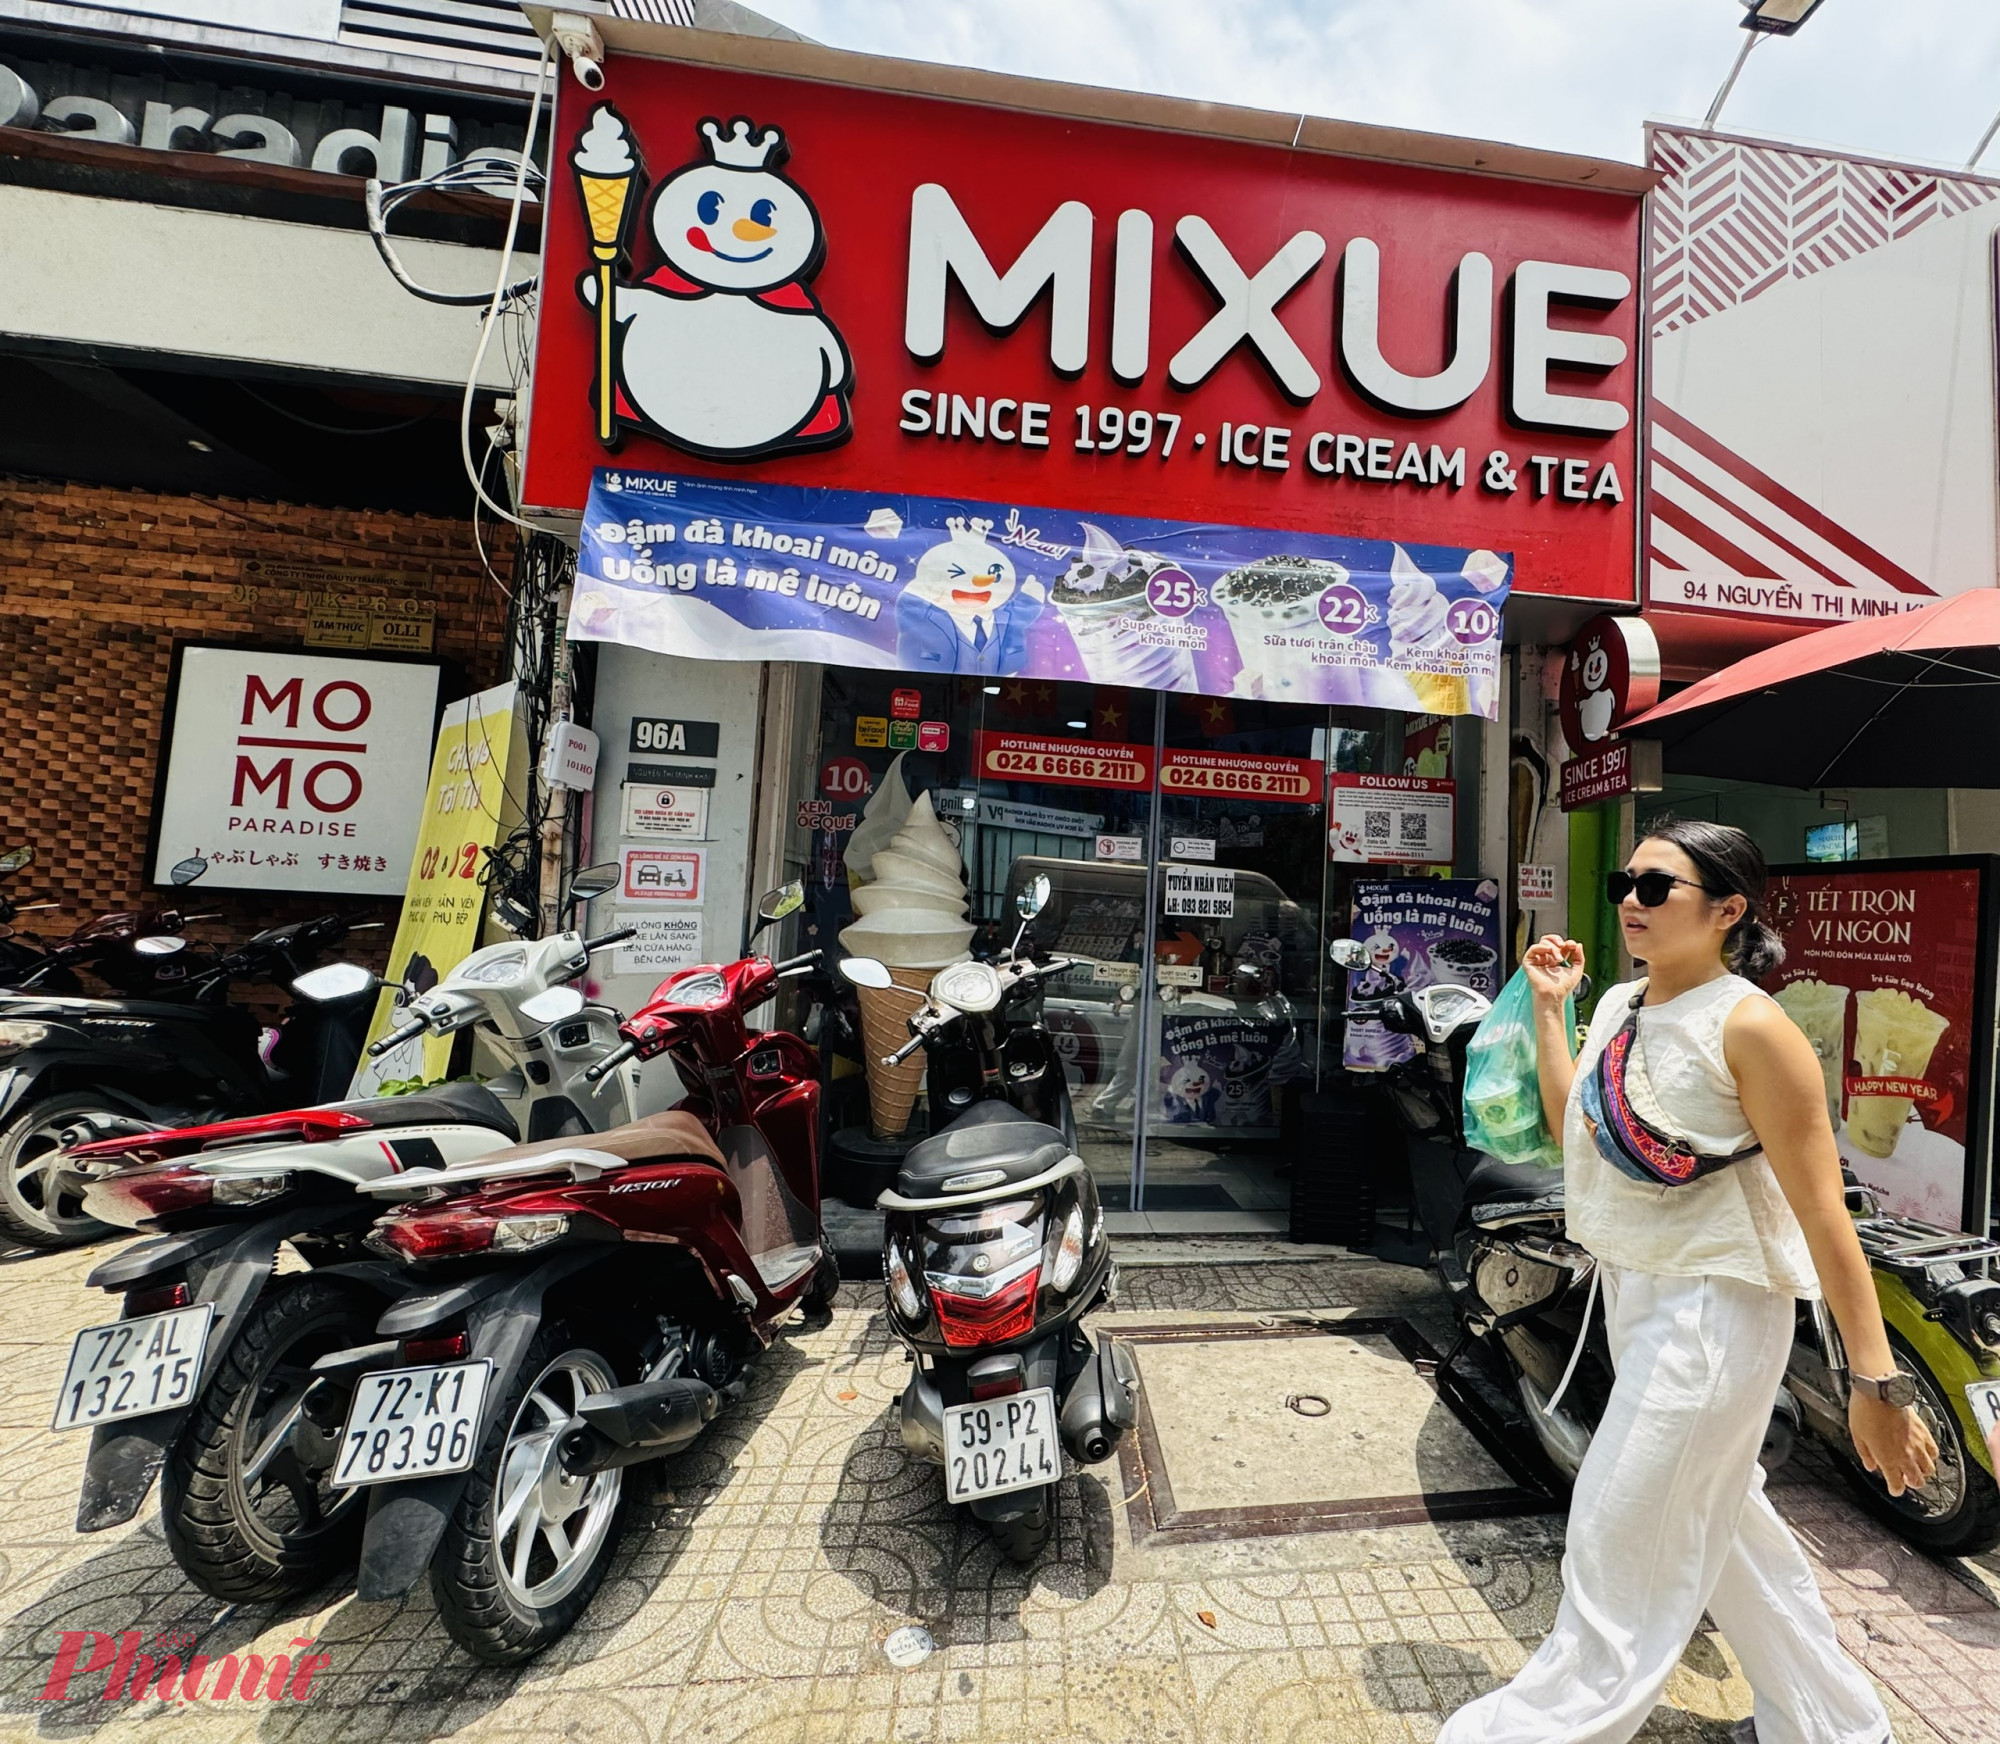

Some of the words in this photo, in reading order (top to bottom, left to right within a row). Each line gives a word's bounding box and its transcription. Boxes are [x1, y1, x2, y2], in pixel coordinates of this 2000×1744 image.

[905, 183, 1632, 432] MIXUE
[900, 388, 1051, 447] SINCE
[1075, 403, 1182, 458] 1997
[1220, 422, 1292, 470] ICE
[1310, 431, 1466, 487] CREAM
[1486, 451, 1518, 491] &
[1532, 455, 1624, 503] TEA
[625, 476, 677, 494] MIXUE
[596, 519, 676, 550] Đậm
[683, 519, 725, 545] đà
[732, 523, 825, 560] khoai
[828, 545, 898, 583] môn
[602, 549, 697, 591] Uống
[705, 558, 738, 587] là
[745, 567, 800, 597] mê
[805, 574, 882, 621] luôn
[1683, 580, 1709, 602] 94
[1718, 582, 1802, 611] NGUYỄN
[1811, 593, 1844, 618] THỊ
[1851, 597, 1898, 617] MINH
[313, 619, 335, 631] TÂM
[337, 618, 365, 633] THỨC
[382, 623, 422, 638] OLLI
[1122, 618, 1159, 633] Super
[1161, 622, 1207, 637] sundae
[1140, 635, 1176, 647] khoai
[1178, 637, 1207, 650] môn
[1263, 634, 1287, 648] Sữa
[1290, 637, 1315, 649] tươi
[1318, 638, 1345, 651] trân
[1347, 639, 1377, 654] châu
[1311, 651, 1347, 666] khoai
[1349, 654, 1377, 668] môn
[1406, 647, 1435, 660] Kem
[1437, 648, 1470, 662] khoai
[1386, 660, 1412, 672] Kem
[1415, 661, 1449, 674] khoai
[1451, 661, 1479, 676] môn
[240, 674, 372, 732] MO
[567, 739, 588, 752] P001
[636, 721, 687, 751] 96A
[1000, 739, 1047, 751] HOTLINE
[1048, 741, 1096, 756] NHƯỢNG
[1097, 744, 1134, 759] QUYỀN
[996, 752, 1038, 772] 024
[1042, 757, 1095, 777] 6666
[1099, 761, 1136, 781] 2111
[1173, 754, 1215, 766] HOTLINE
[1217, 757, 1263, 771] NHƯỢNG
[1264, 759, 1299, 773] QUYỀN
[1564, 757, 1599, 787] SINCE
[1601, 746, 1628, 776] 1997
[230, 755, 363, 813] MO
[1169, 768, 1208, 787] 024
[1212, 771, 1263, 790] 6666
[1266, 775, 1301, 794] 2111
[1359, 776, 1411, 789] FOLLOW
[1412, 778, 1429, 790] US
[1564, 787, 1577, 805] ICE
[1576, 781, 1604, 801] CREAM
[1603, 780, 1611, 793] &
[1610, 774, 1628, 791] TEA
[797, 800, 832, 814] KEM
[228, 816, 357, 838] PARADISE
[318, 853, 388, 872] すき焼き
[1167, 867, 1193, 892] TUYỂN
[1193, 871, 1215, 893] NHÂN
[1215, 872, 1234, 893] VIÊN
[1366, 884, 1390, 892] MIXUE
[1166, 898, 1181, 914] LH:
[1181, 899, 1197, 915] 093
[1198, 899, 1211, 916] 821
[1212, 900, 1233, 916] 5854
[1360, 893, 1393, 908] Đậm
[1395, 891, 1414, 904] đà
[1416, 893, 1456, 908] khoai
[1458, 901, 1492, 918] môn
[1806, 881, 1843, 912] TẾT
[1848, 888, 1916, 916] TRỌN
[663, 919, 698, 929] KHÔNG
[1363, 905, 1402, 925] Uống
[1405, 908, 1420, 923] là
[1422, 912, 1447, 927] mê
[1449, 915, 1485, 937] luôn
[635, 933, 650, 941] XE
[670, 933, 696, 941] SANG
[1808, 919, 1832, 945] VỊ
[1836, 919, 1911, 945] NGON
[666, 943, 693, 952] HÀNG
[1821, 948, 1836, 957] MỚI
[1854, 950, 1872, 960] MÙA
[1872, 951, 1896, 962] XUÂN
[1897, 952, 1912, 963] TỚI
[634, 954, 653, 964] BÊN
[1471, 976, 1489, 988] 22
[1193, 1020, 1209, 1033] đà
[1171, 1037, 1205, 1055] Uống
[1205, 1033, 1219, 1045] là
[1219, 1031, 1240, 1044] mê
[1240, 1031, 1269, 1045] luôn
[1227, 1084, 1242, 1096] 25
[1853, 1079, 1885, 1095] HAPPY
[1885, 1080, 1908, 1095] NEW
[1908, 1082, 1938, 1101] YEAR
[608, 1177, 682, 1196] VISION
[89, 1317, 182, 1374] 72-AL
[68, 1356, 192, 1424] 132.15
[368, 1368, 465, 1424] 72-K1
[960, 1399, 1040, 1446] 59-P2
[342, 1419, 470, 1477] 783.96
[953, 1446, 1052, 1494] 202.44
